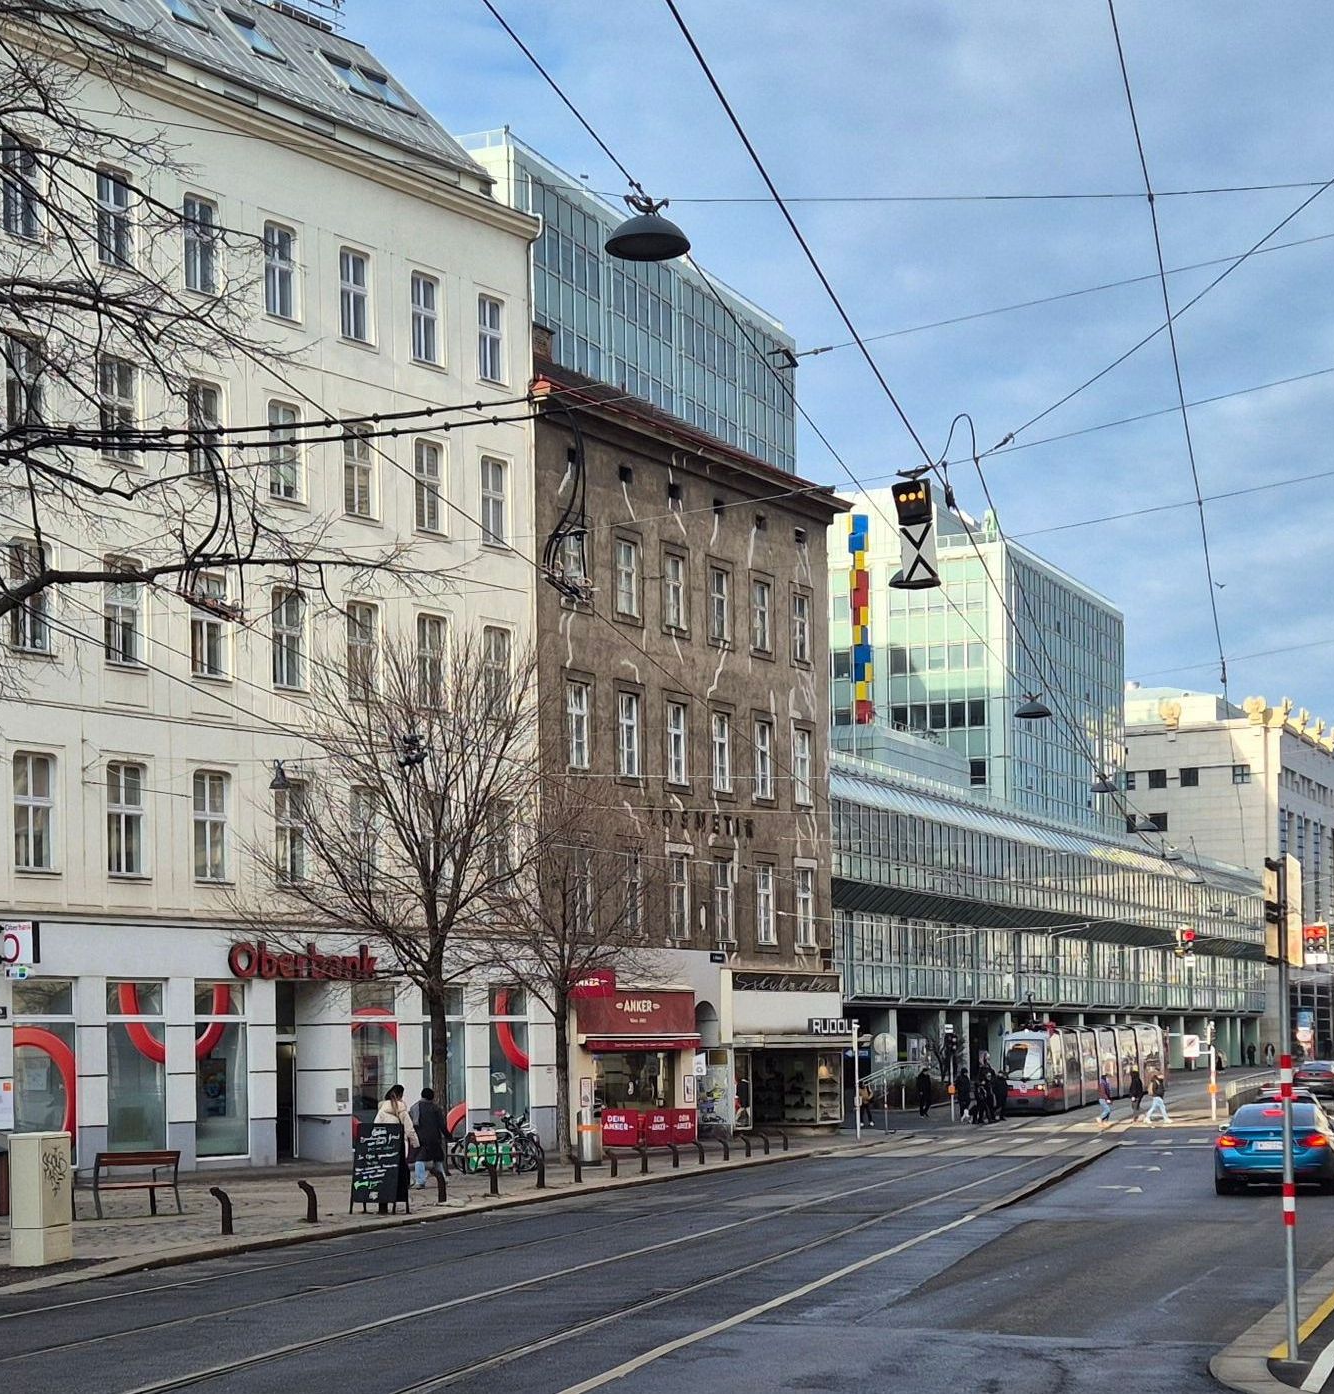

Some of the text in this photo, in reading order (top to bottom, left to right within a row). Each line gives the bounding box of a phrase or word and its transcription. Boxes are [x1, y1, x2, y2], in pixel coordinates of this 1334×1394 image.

[228, 939, 379, 980] Oberbank
[623, 999, 653, 1013] ANKER
[607, 1115, 626, 1123] DEIN
